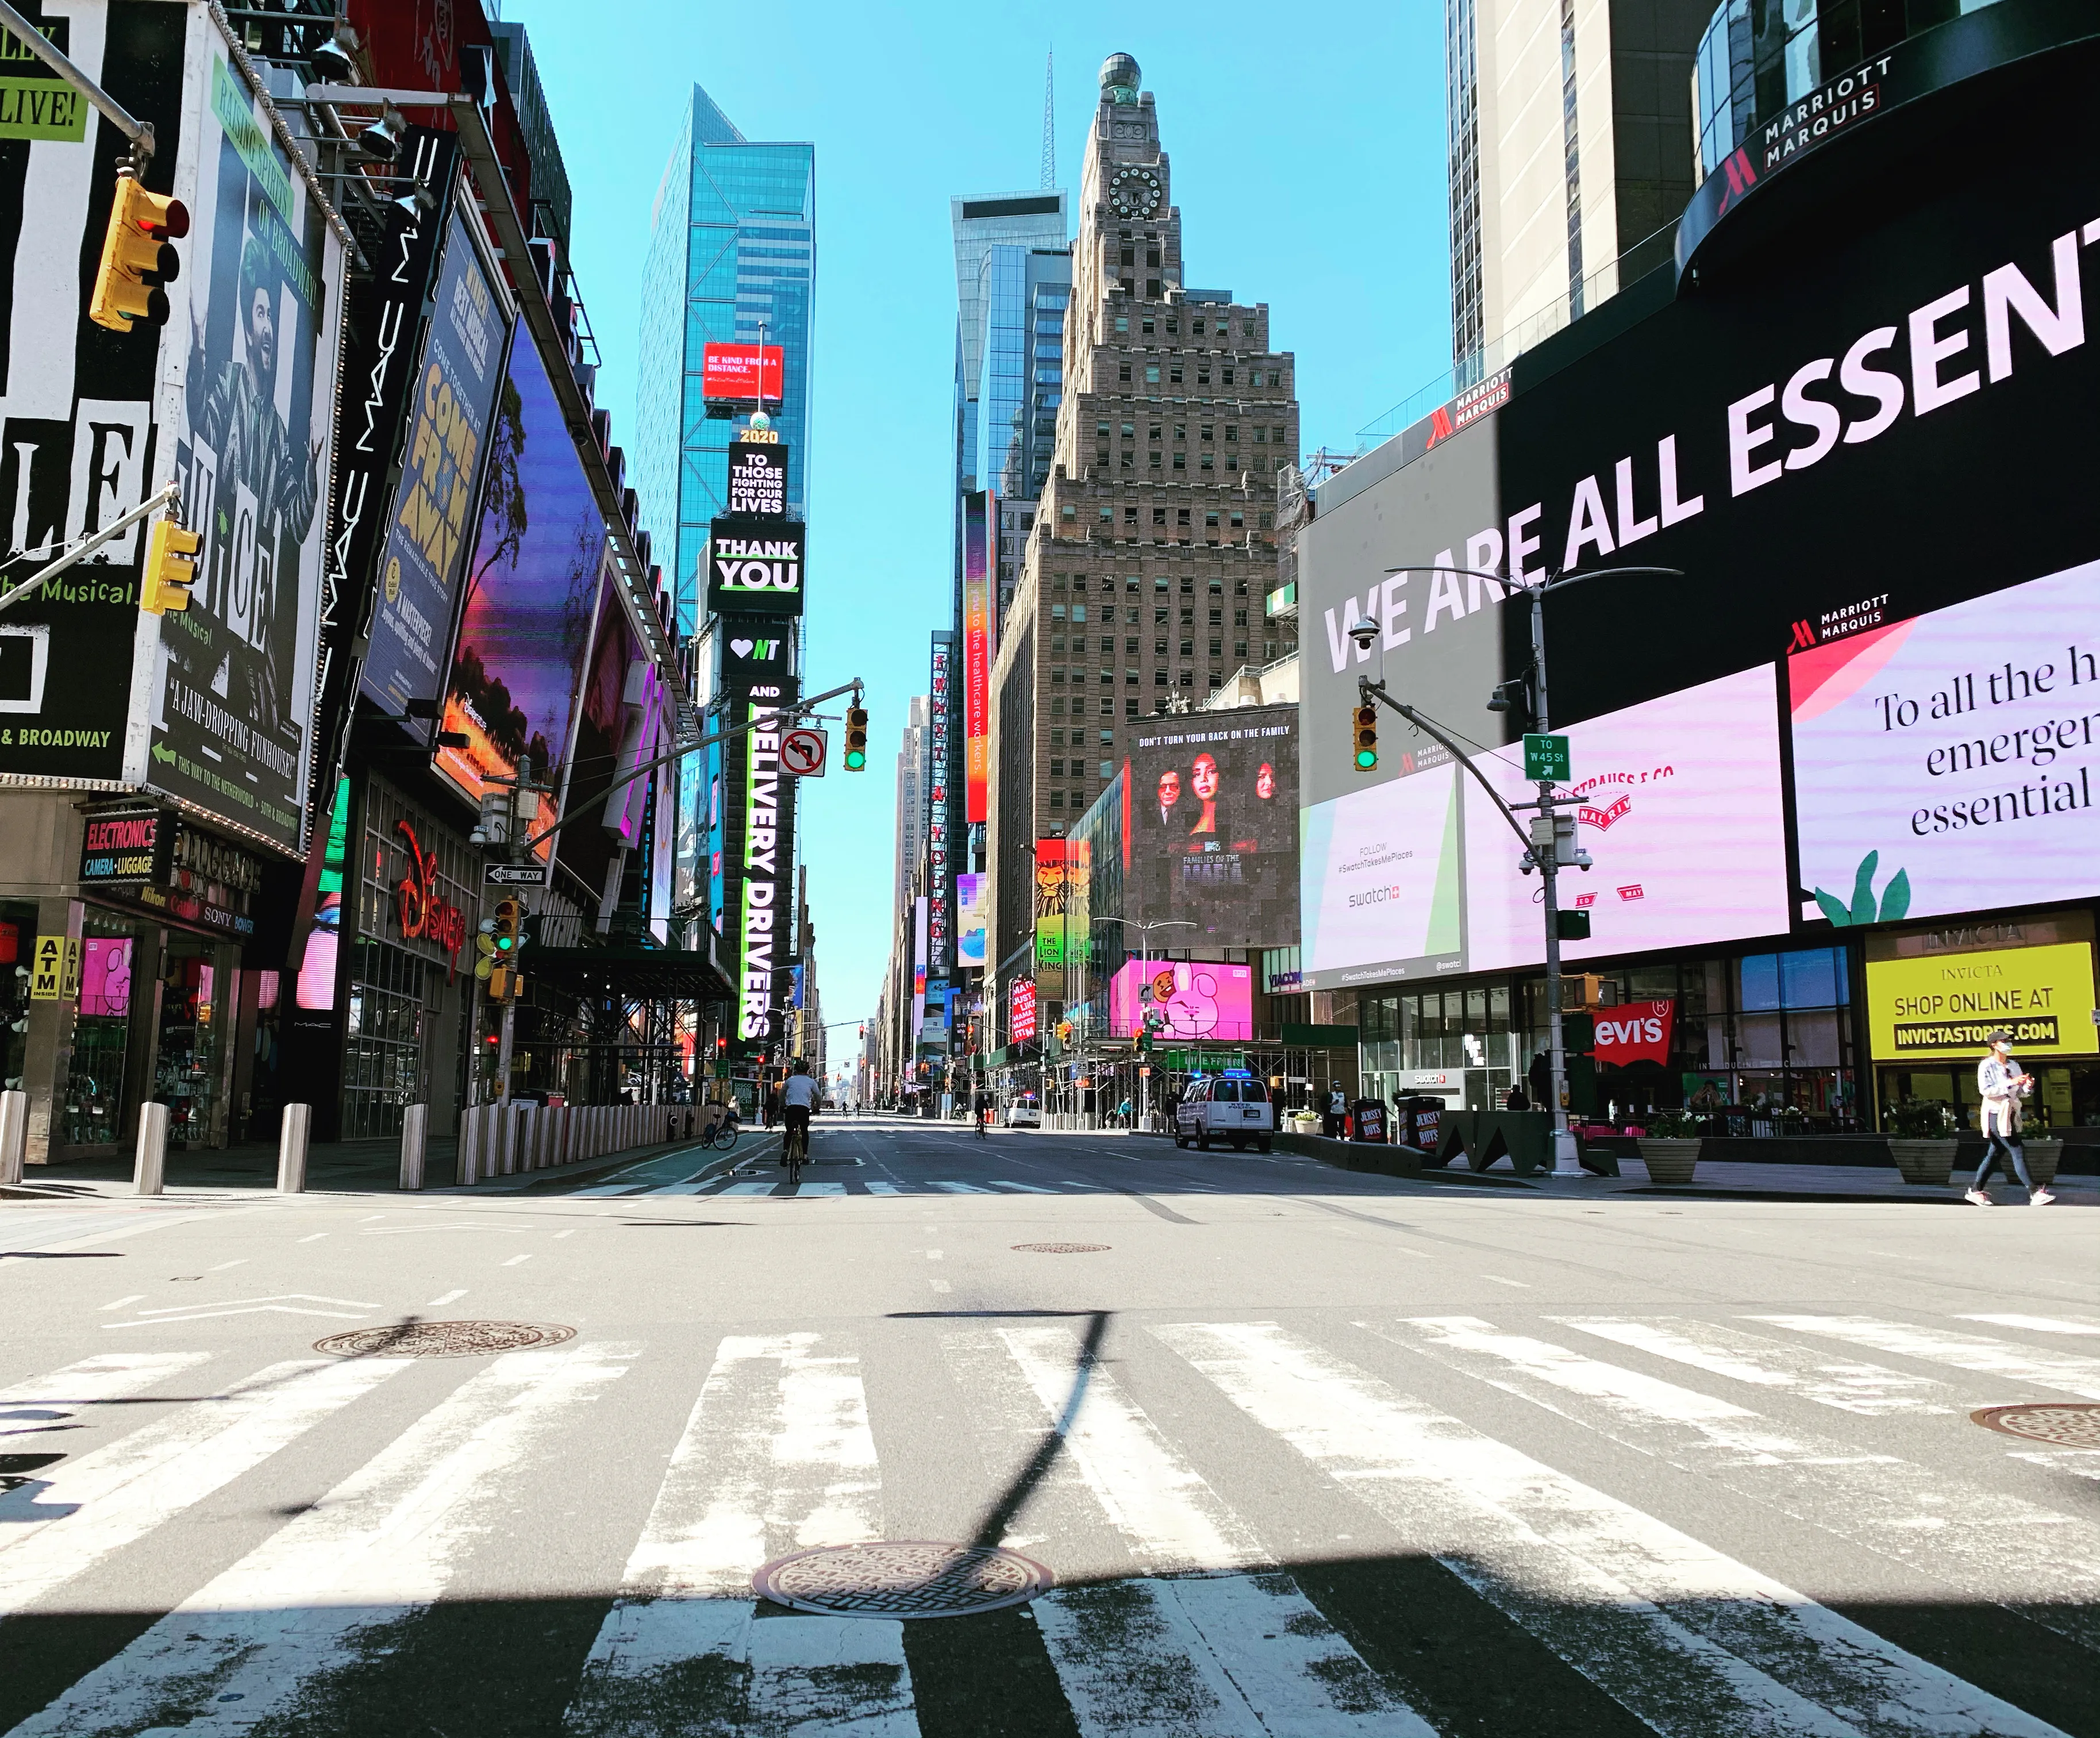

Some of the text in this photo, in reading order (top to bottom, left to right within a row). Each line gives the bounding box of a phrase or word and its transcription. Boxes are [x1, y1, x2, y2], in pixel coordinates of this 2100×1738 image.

[1766, 56, 1891, 145] MARRIOTT
[1767, 91, 1875, 168] MARQUIS
[220, 76, 287, 218] RAISING SPIRITS
[259, 198, 317, 310] ON BROADWAY!
[453, 275, 489, 367] BEST MUSICAL
[708, 364, 751, 373] DISTANCE.
[722, 356, 743, 364] KIND
[434, 338, 481, 434] COME TOGETHER AT
[1457, 366, 1513, 410] MARRIOTT
[1457, 387, 1507, 427] MARQUIS
[425, 363, 478, 486] COME
[740, 430, 778, 444] 2020
[1325, 216, 2100, 674] WE ARE ALL ESSEN
[746, 454, 767, 466] TO
[733, 466, 782, 479] THOSE
[732, 479, 782, 489] FIGHTING
[732, 487, 782, 498] FOR OUR
[732, 498, 782, 514] LIVES
[399, 479, 459, 586] AWAY
[716, 539, 799, 558] THANK
[395, 528, 448, 604] THE REMARKABLE TRUE STORY
[716, 560, 798, 590] YOU
[972, 613, 981, 626] to
[1821, 594, 1889, 625] MARRIOTT
[400, 594, 432, 649] MASTERPIECE!
[1822, 612, 1882, 639] MARQUIS
[973, 629, 982, 650] the
[749, 686, 780, 697] AND
[1875, 694, 1919, 732] To
[1931, 674, 1977, 720] all
[1987, 663, 2055, 706] the
[932, 655, 947, 761] ERNST
[182, 686, 248, 752] JAW-DROPPING
[1, 729, 110, 747] & BROADWAY
[1140, 725, 1290, 747] DON'T TURN YOUR BACK ON THE FAMILY
[1541, 740, 1552, 749] TO
[974, 721, 982, 774] workers.
[1530, 753, 1564, 762] W 45 St
[1417, 751, 1449, 767] MARQUIS
[179, 755, 190, 775] THIS
[191, 762, 203, 782] WAY
[203, 768, 211, 786] TO
[211, 773, 221, 791] THE
[221, 779, 254, 809] NETHERWORLD
[1911, 767, 2093, 836] essential
[87, 818, 156, 850] ELECTRONICS
[1183, 855, 1214, 864] FAMILIES
[1226, 854, 1239, 862] THE
[1360, 842, 1387, 857] FOLLOW
[85, 856, 152, 876] CAMERA LUGGAGE
[742, 707, 780, 1039] DELIVERY DRIVERS
[1339, 851, 1413, 874] #SwatchTakesMePlaces
[494, 871, 539, 879] ONE WAY
[930, 825, 944, 938] YOUNG
[141, 886, 166, 908] Nikon
[204, 906, 232, 927] SONY
[1349, 885, 1391, 908] swatch
[1043, 937, 1056, 945] THE
[1925, 923, 2023, 949] INVICTA
[1040, 946, 1059, 958] LION
[37, 940, 58, 990] ATM
[66, 941, 77, 991] ATM
[1038, 959, 1063, 972] KING
[1341, 967, 1405, 982] #SwatchTakesMePlaces
[1941, 964, 2003, 980] INVICTA
[1268, 972, 1303, 987] VIACOM
[1014, 993, 1032, 1005] JUST
[1895, 987, 2053, 1017] SHOP ONLINE AT
[1013, 1010, 1033, 1021] MAMA
[1013, 1017, 1034, 1029] MAKES
[1414, 1074, 1439, 1084] swatch
[1361, 1108, 1382, 1122] JERSEY
[1416, 1110, 1441, 1127] JERSEY
[1363, 1123, 1380, 1136] BOYS
[1419, 1129, 1439, 1145] BOYS
